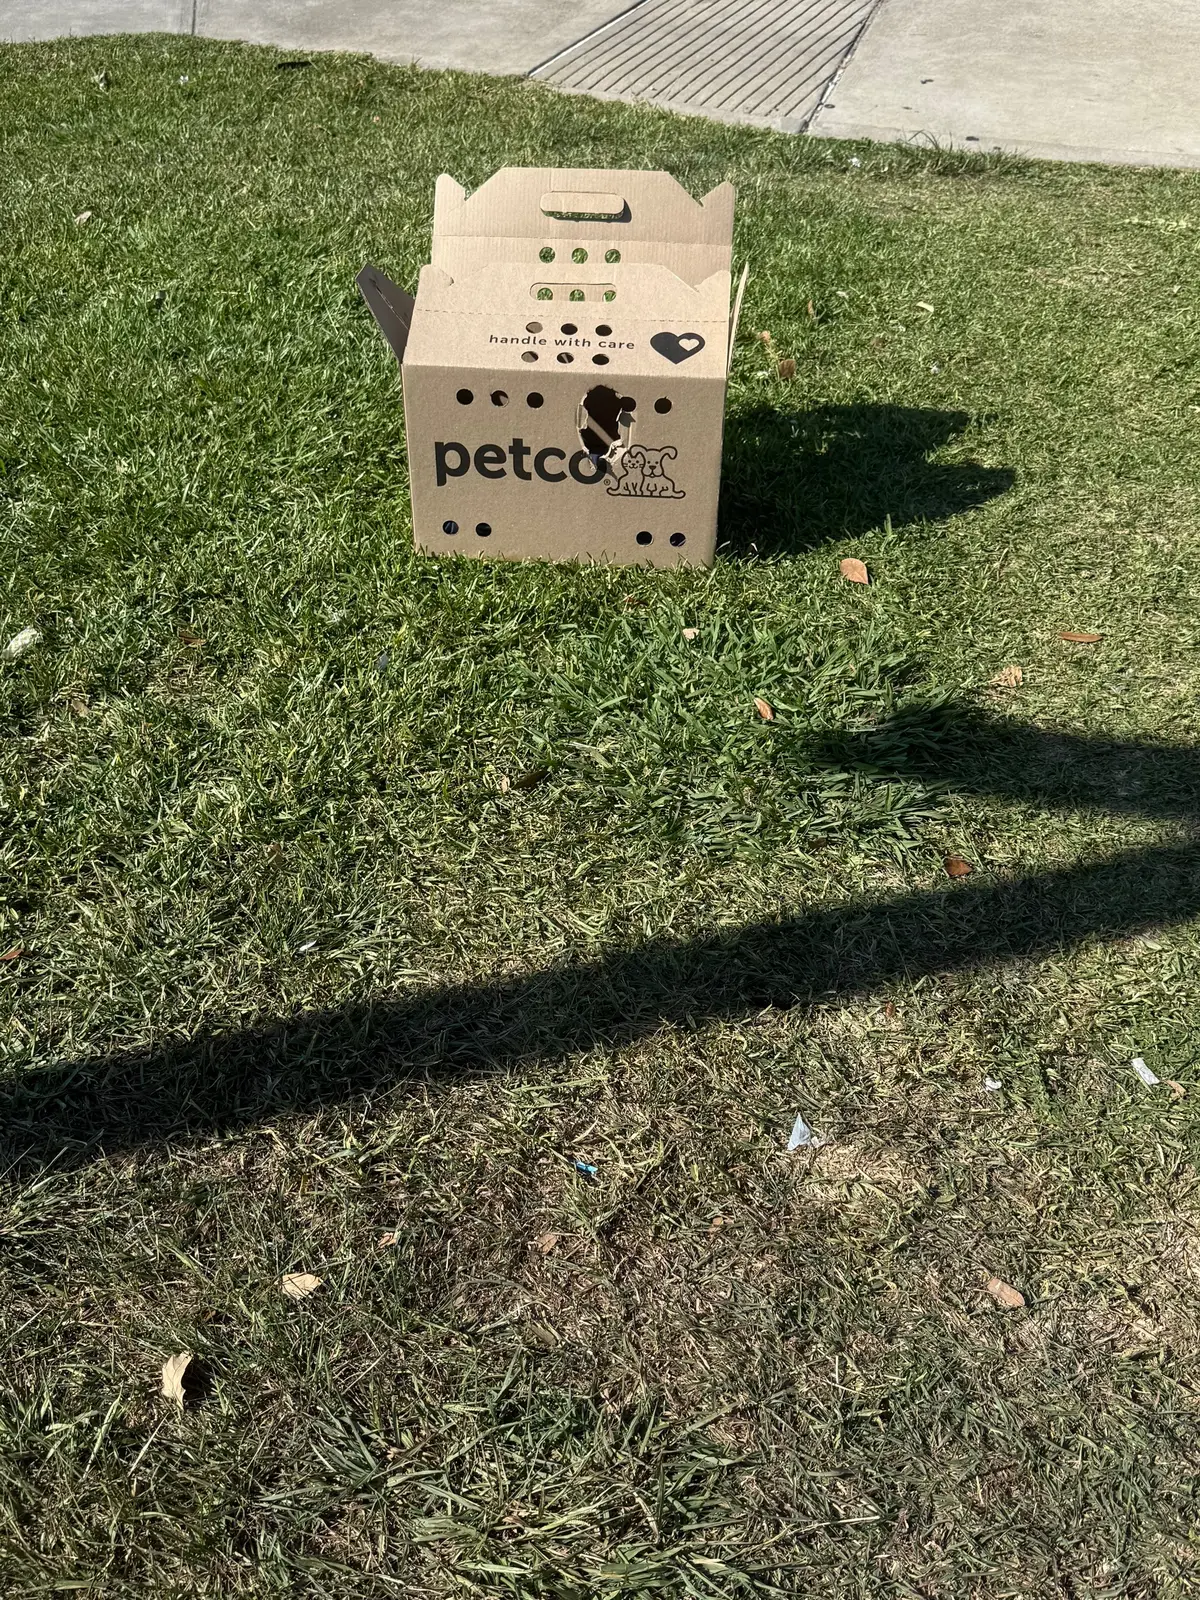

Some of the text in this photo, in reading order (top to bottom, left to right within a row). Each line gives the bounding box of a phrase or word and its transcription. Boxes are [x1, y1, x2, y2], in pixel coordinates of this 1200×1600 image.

[489, 334, 636, 350] handle with care
[434, 437, 608, 487] petco
